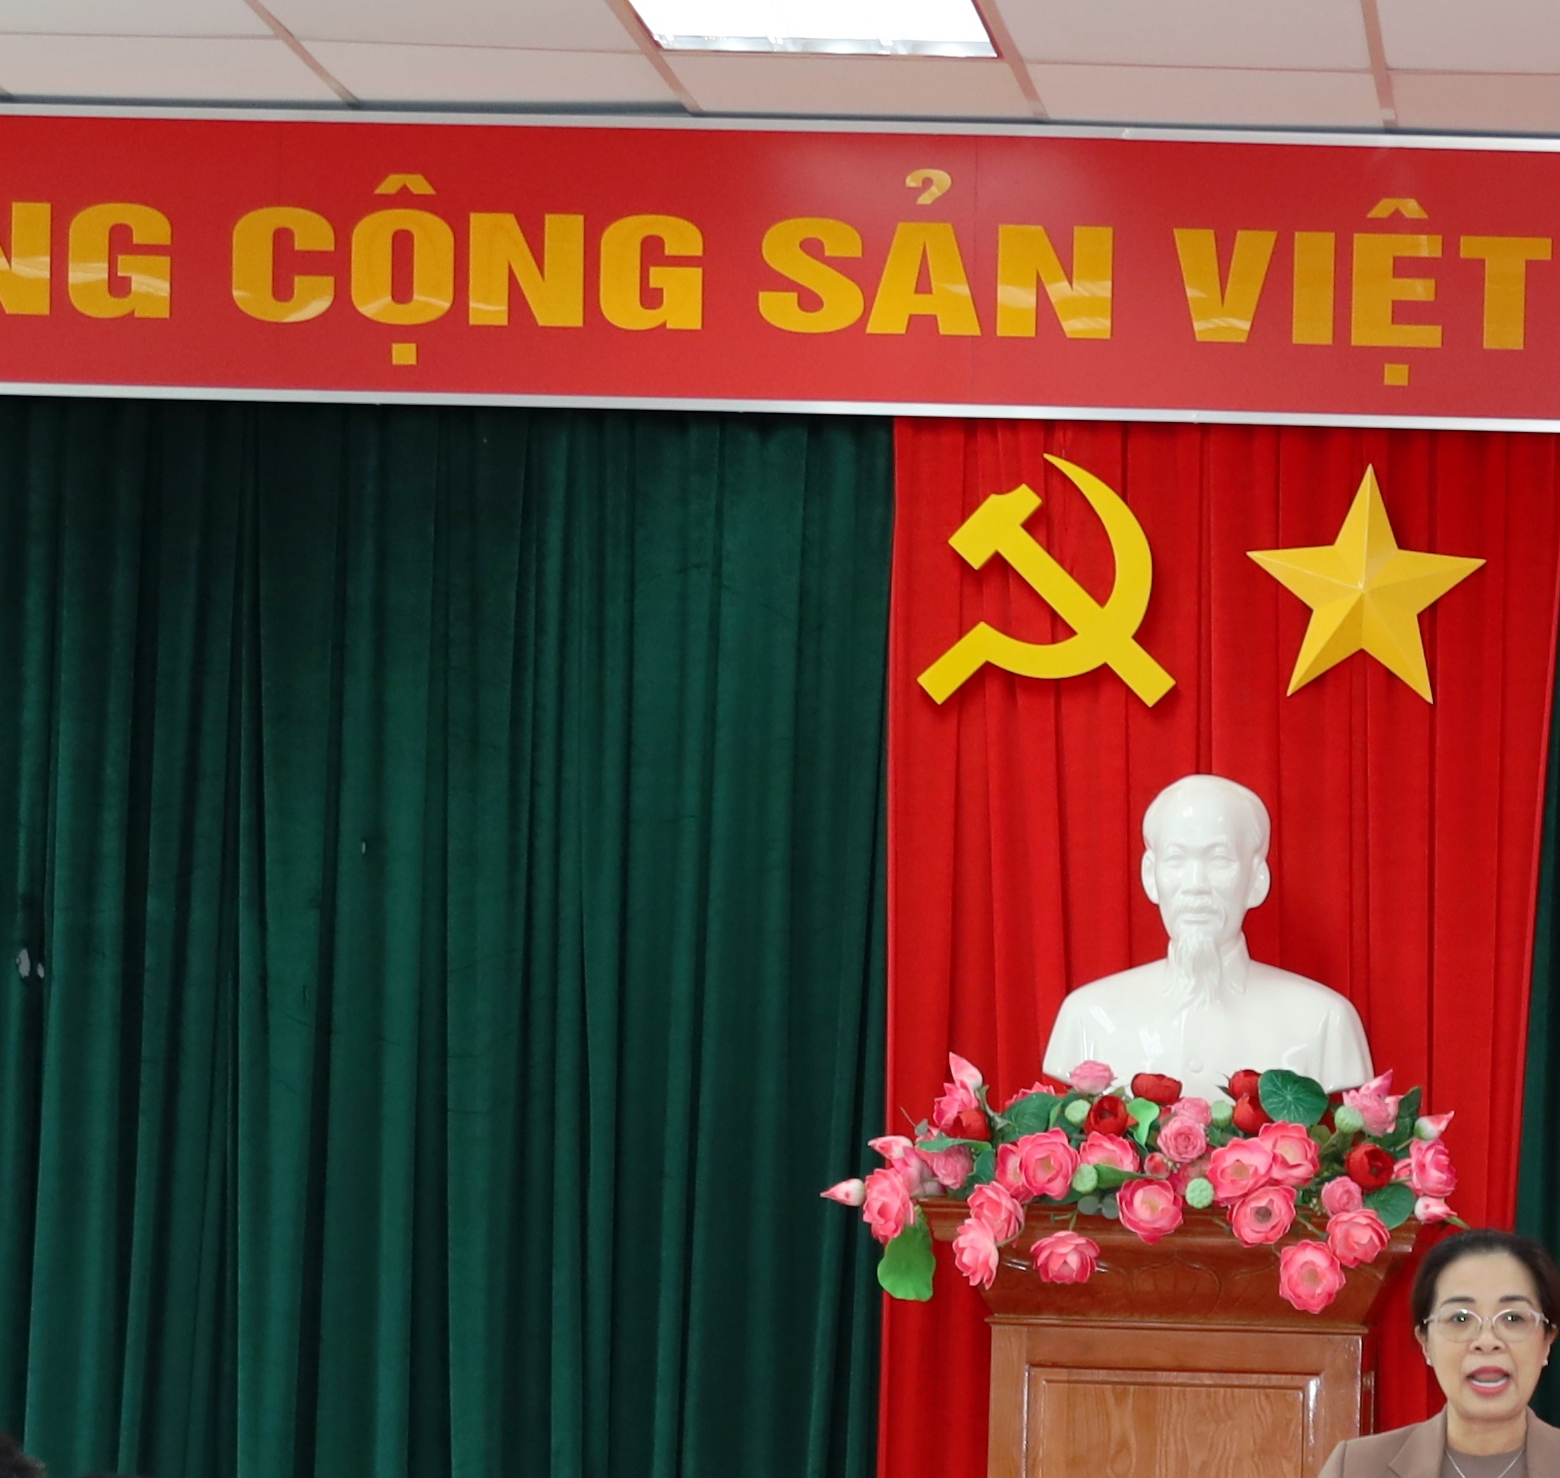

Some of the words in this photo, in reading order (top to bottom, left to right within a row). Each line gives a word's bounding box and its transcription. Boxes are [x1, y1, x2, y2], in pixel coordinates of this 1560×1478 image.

[232, 174, 703, 365] CỘNG
[758, 169, 1113, 340] SẢN
[1173, 198, 1552, 386] VIỆT
